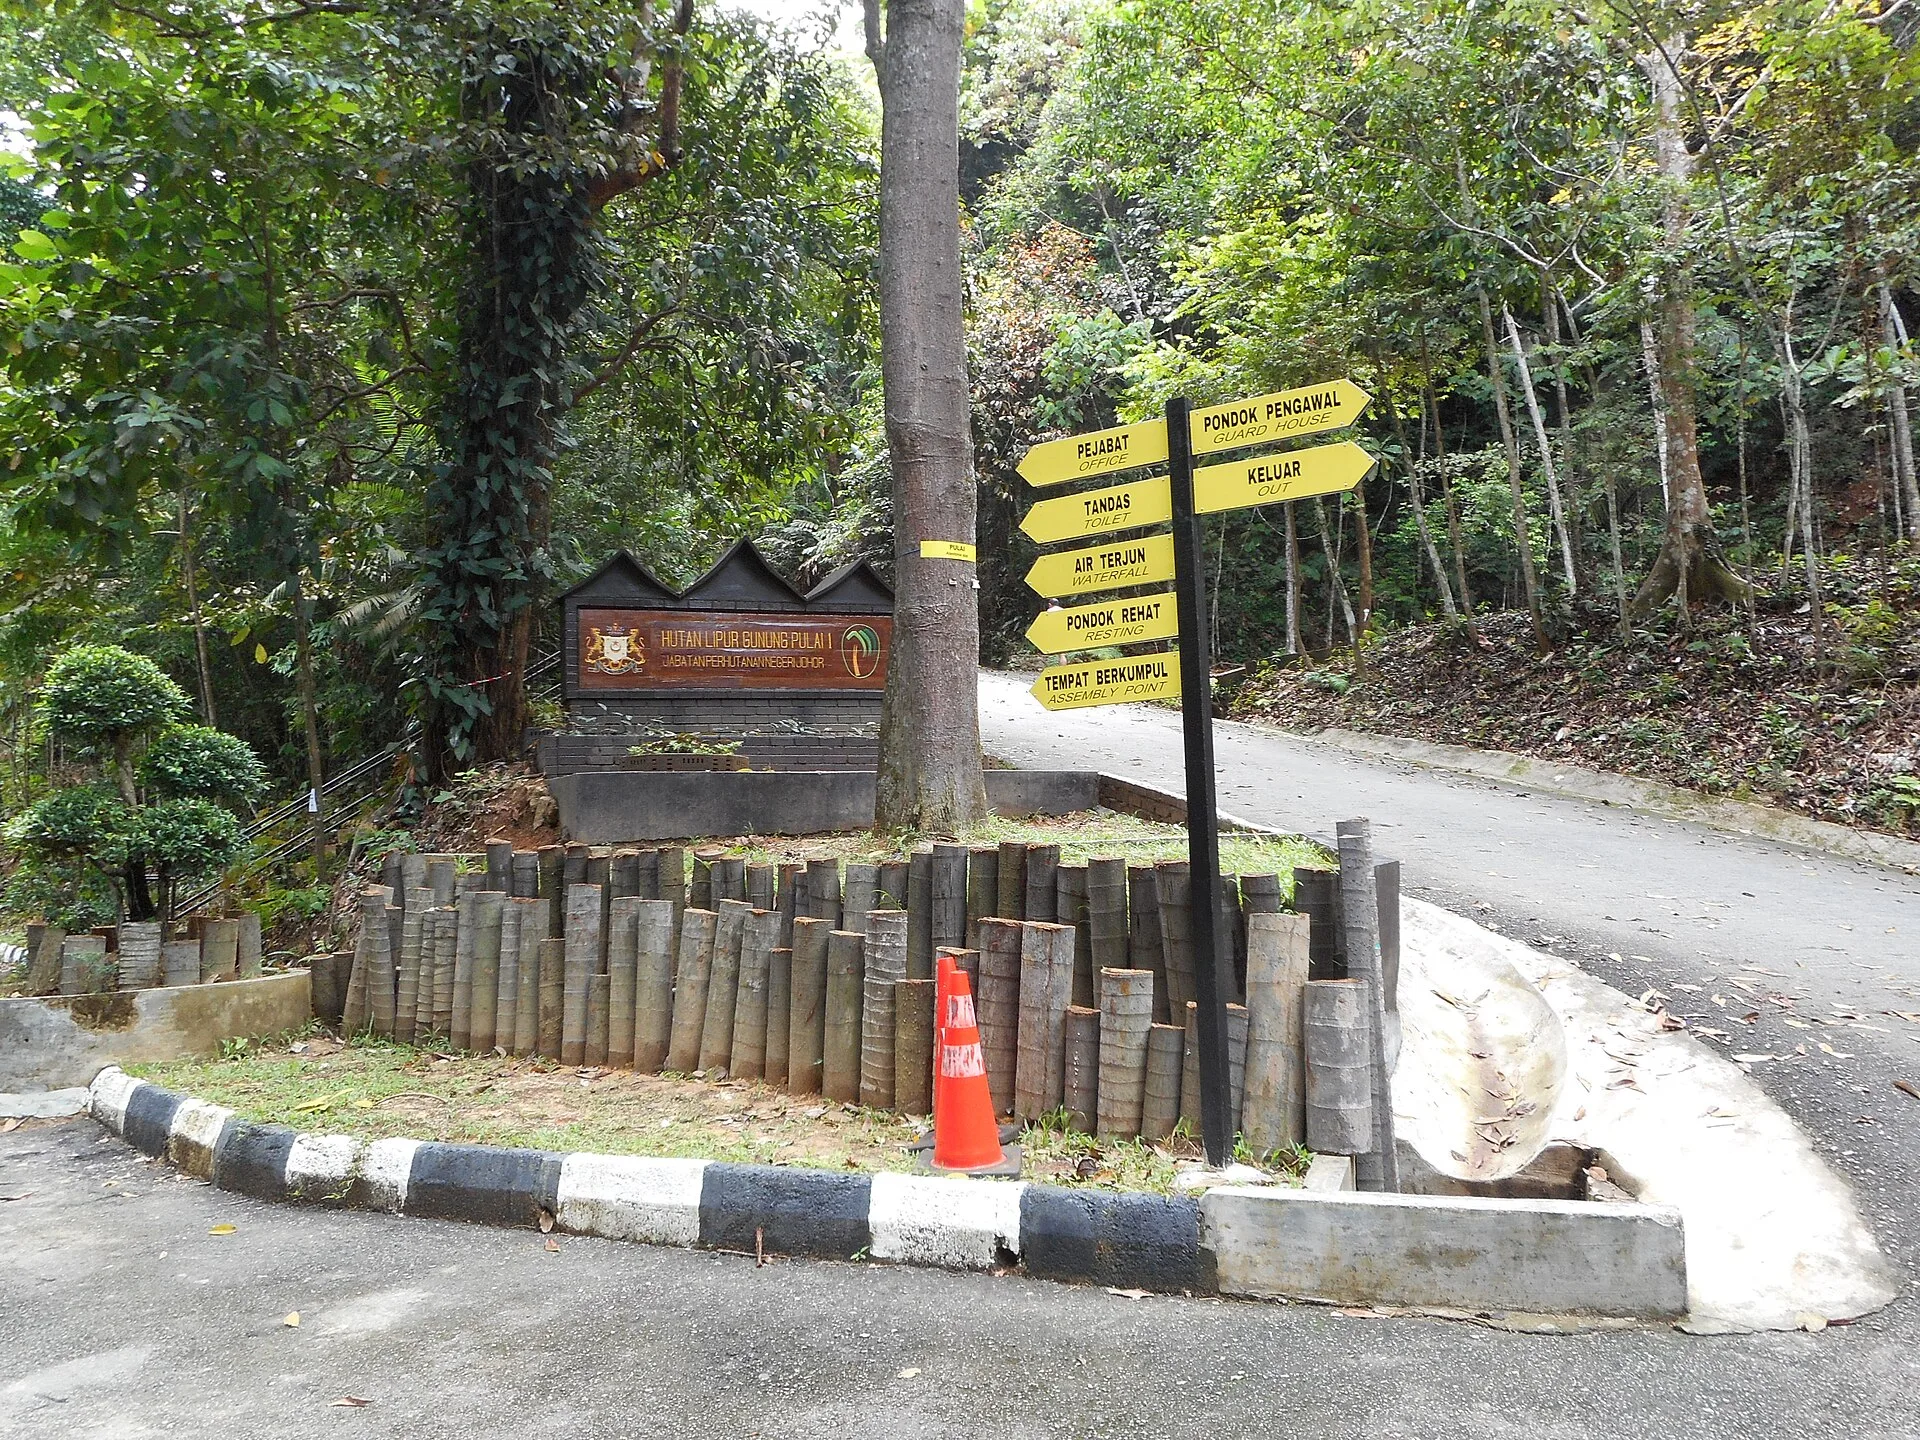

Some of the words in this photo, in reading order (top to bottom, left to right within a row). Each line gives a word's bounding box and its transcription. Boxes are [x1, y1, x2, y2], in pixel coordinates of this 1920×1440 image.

[1204, 407, 1258, 432] PONDOK
[1266, 391, 1341, 420] PENGAWAL
[1213, 425, 1267, 444] GUARD
[1275, 412, 1332, 432] HOUSE
[1077, 435, 1129, 459] PEJABAT
[1079, 453, 1129, 471] OFFICE
[1247, 460, 1301, 484] KELUAR
[1258, 481, 1292, 497] OUT
[1084, 494, 1130, 516] TANDAS
[1084, 512, 1131, 529] TOILET
[1074, 557, 1094, 573] AIR
[1100, 547, 1146, 569] TERJUN
[1072, 566, 1149, 586] WATERFALL
[1067, 610, 1114, 631] PONDOK
[1122, 603, 1161, 623] REHAT
[661, 630, 702, 648] HUTAN
[705, 631, 739, 648] LIPUR
[742, 631, 788, 649] GUNUNG
[791, 632, 824, 649] PULAI
[1084, 624, 1145, 642] RESTING
[1045, 671, 1089, 691] TEMPAT
[1096, 662, 1168, 686] BERKUMPUL
[1047, 687, 1119, 705] ASSEMBLY
[1124, 681, 1167, 695] POINT
